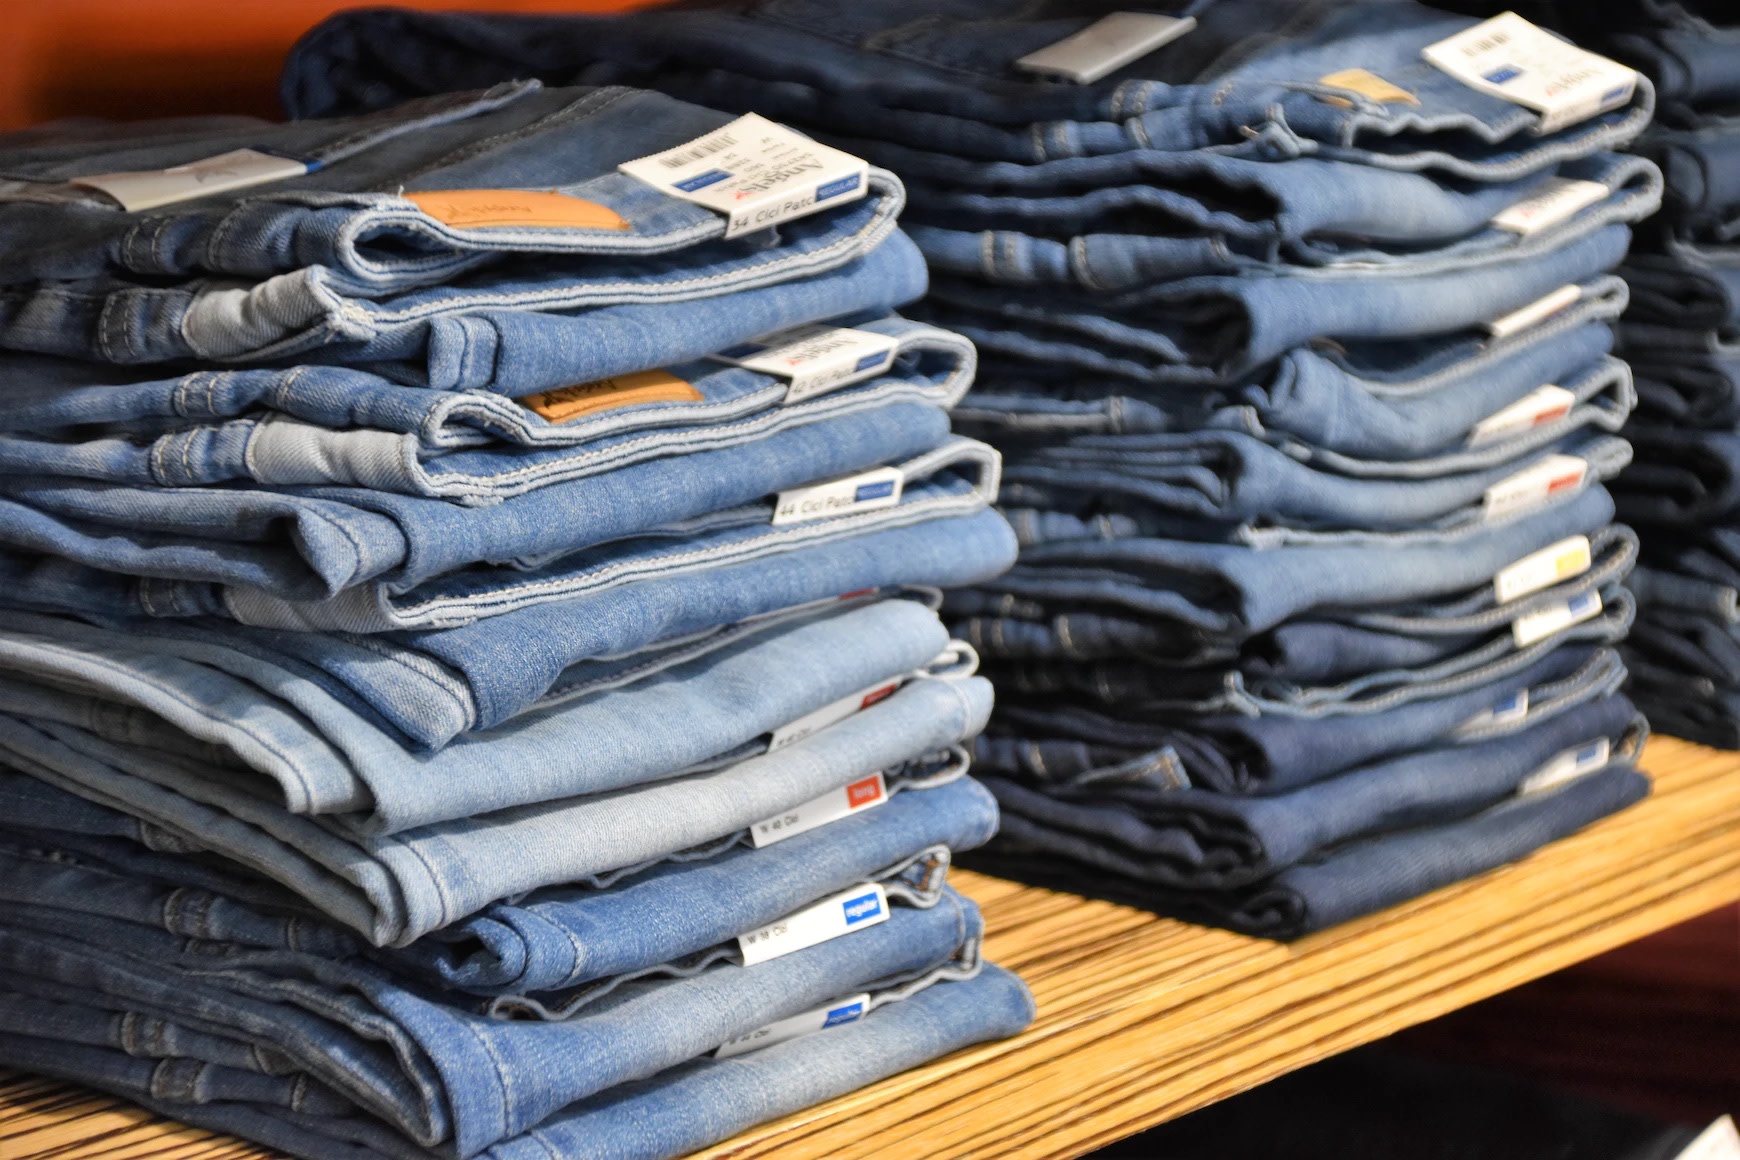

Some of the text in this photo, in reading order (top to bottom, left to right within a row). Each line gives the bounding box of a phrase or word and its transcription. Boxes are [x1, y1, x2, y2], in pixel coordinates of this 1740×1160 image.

[818, 177, 860, 197] REGULAR
[756, 206, 780, 223] Cici
[845, 899, 879, 917] regular
